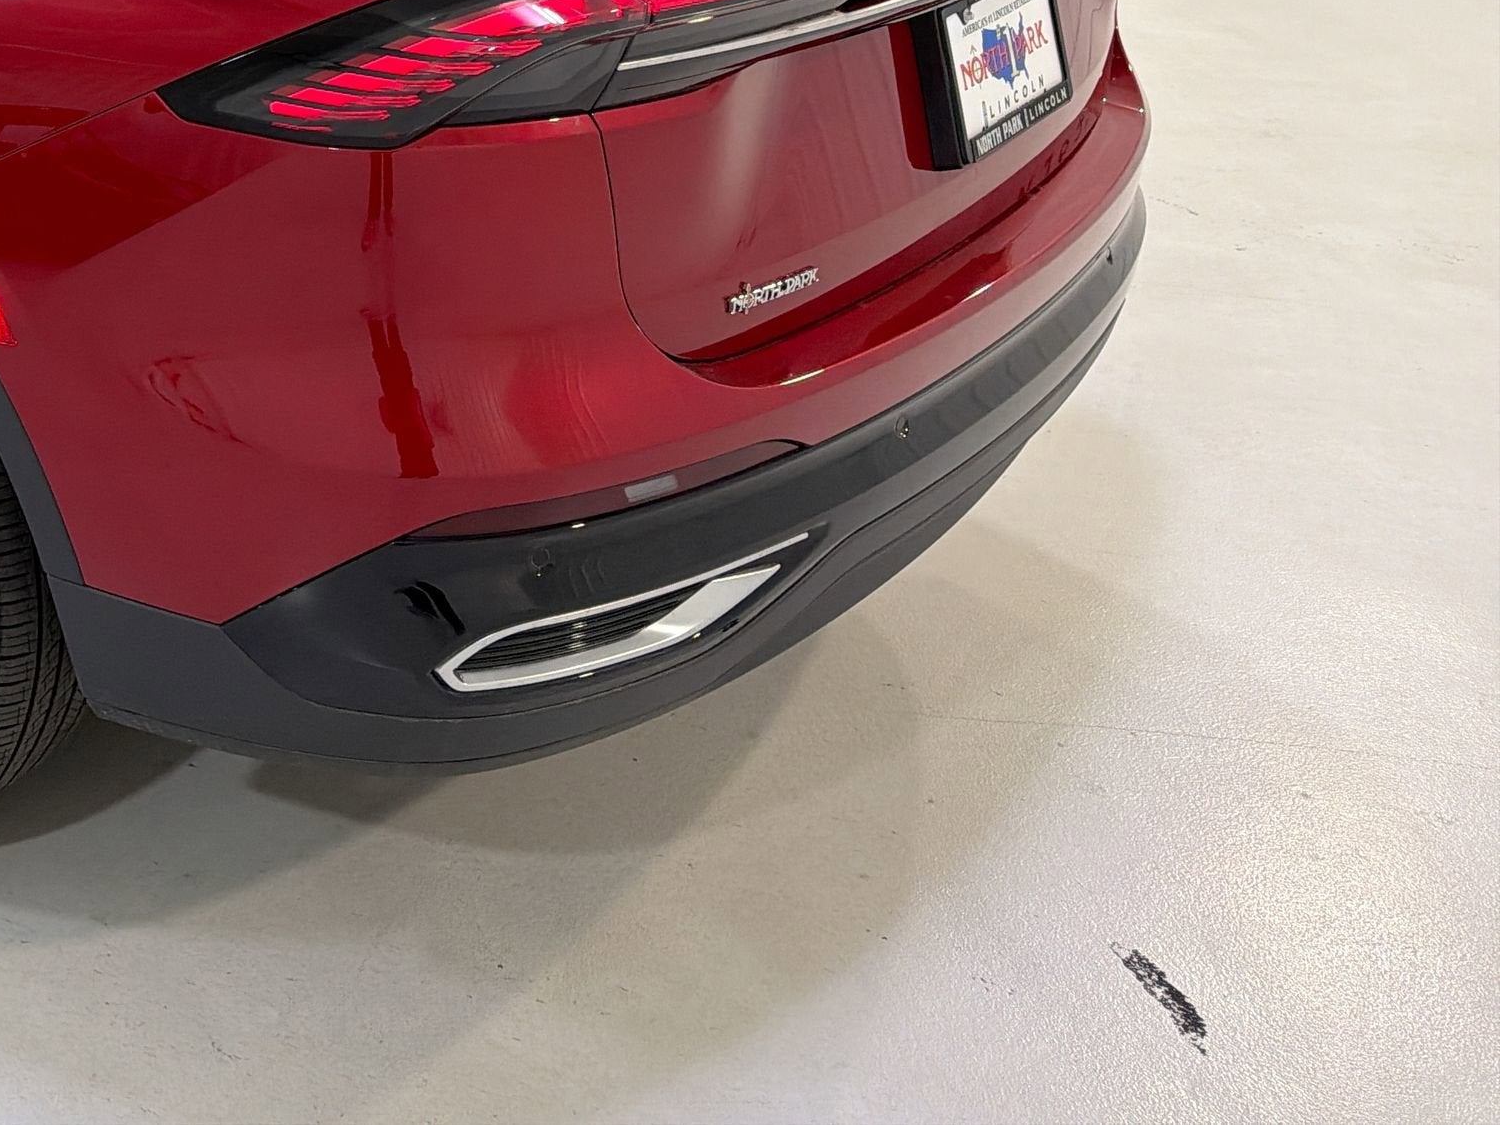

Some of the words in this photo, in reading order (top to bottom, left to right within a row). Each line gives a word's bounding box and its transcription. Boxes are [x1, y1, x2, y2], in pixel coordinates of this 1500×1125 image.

[992, 3, 1016, 22] LINCOLN
[960, 41, 1011, 91] NORTH
[1012, 19, 1049, 59] PARK
[975, 127, 1003, 157] NORTH
[1003, 112, 1024, 140] PARK
[1028, 86, 1068, 121] LINCOLN
[988, 75, 1046, 118] LINCOLN
